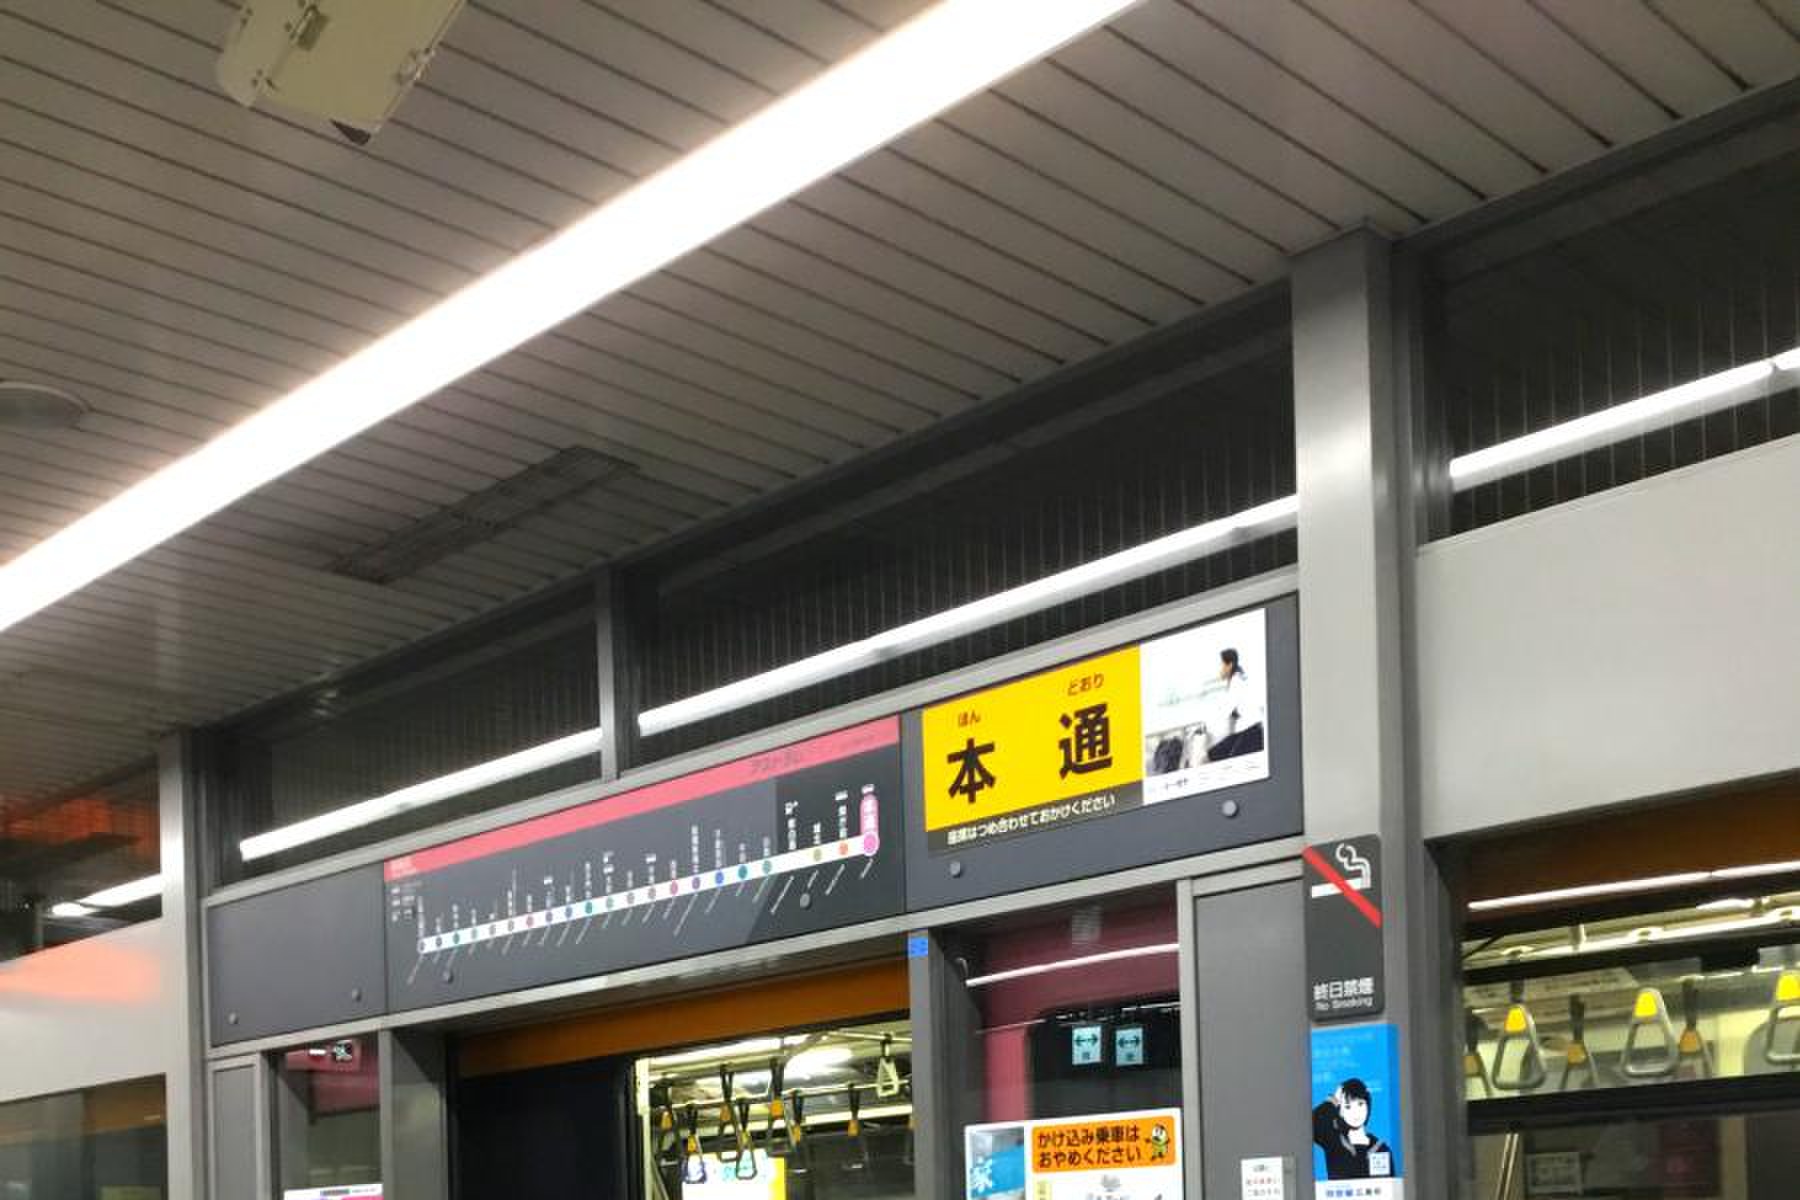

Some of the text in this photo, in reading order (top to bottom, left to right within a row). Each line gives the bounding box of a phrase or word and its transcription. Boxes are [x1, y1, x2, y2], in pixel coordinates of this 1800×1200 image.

[1039, 1124, 1140, 1149] かけ込み乗車は
[1039, 1146, 1143, 1169] おやめください
